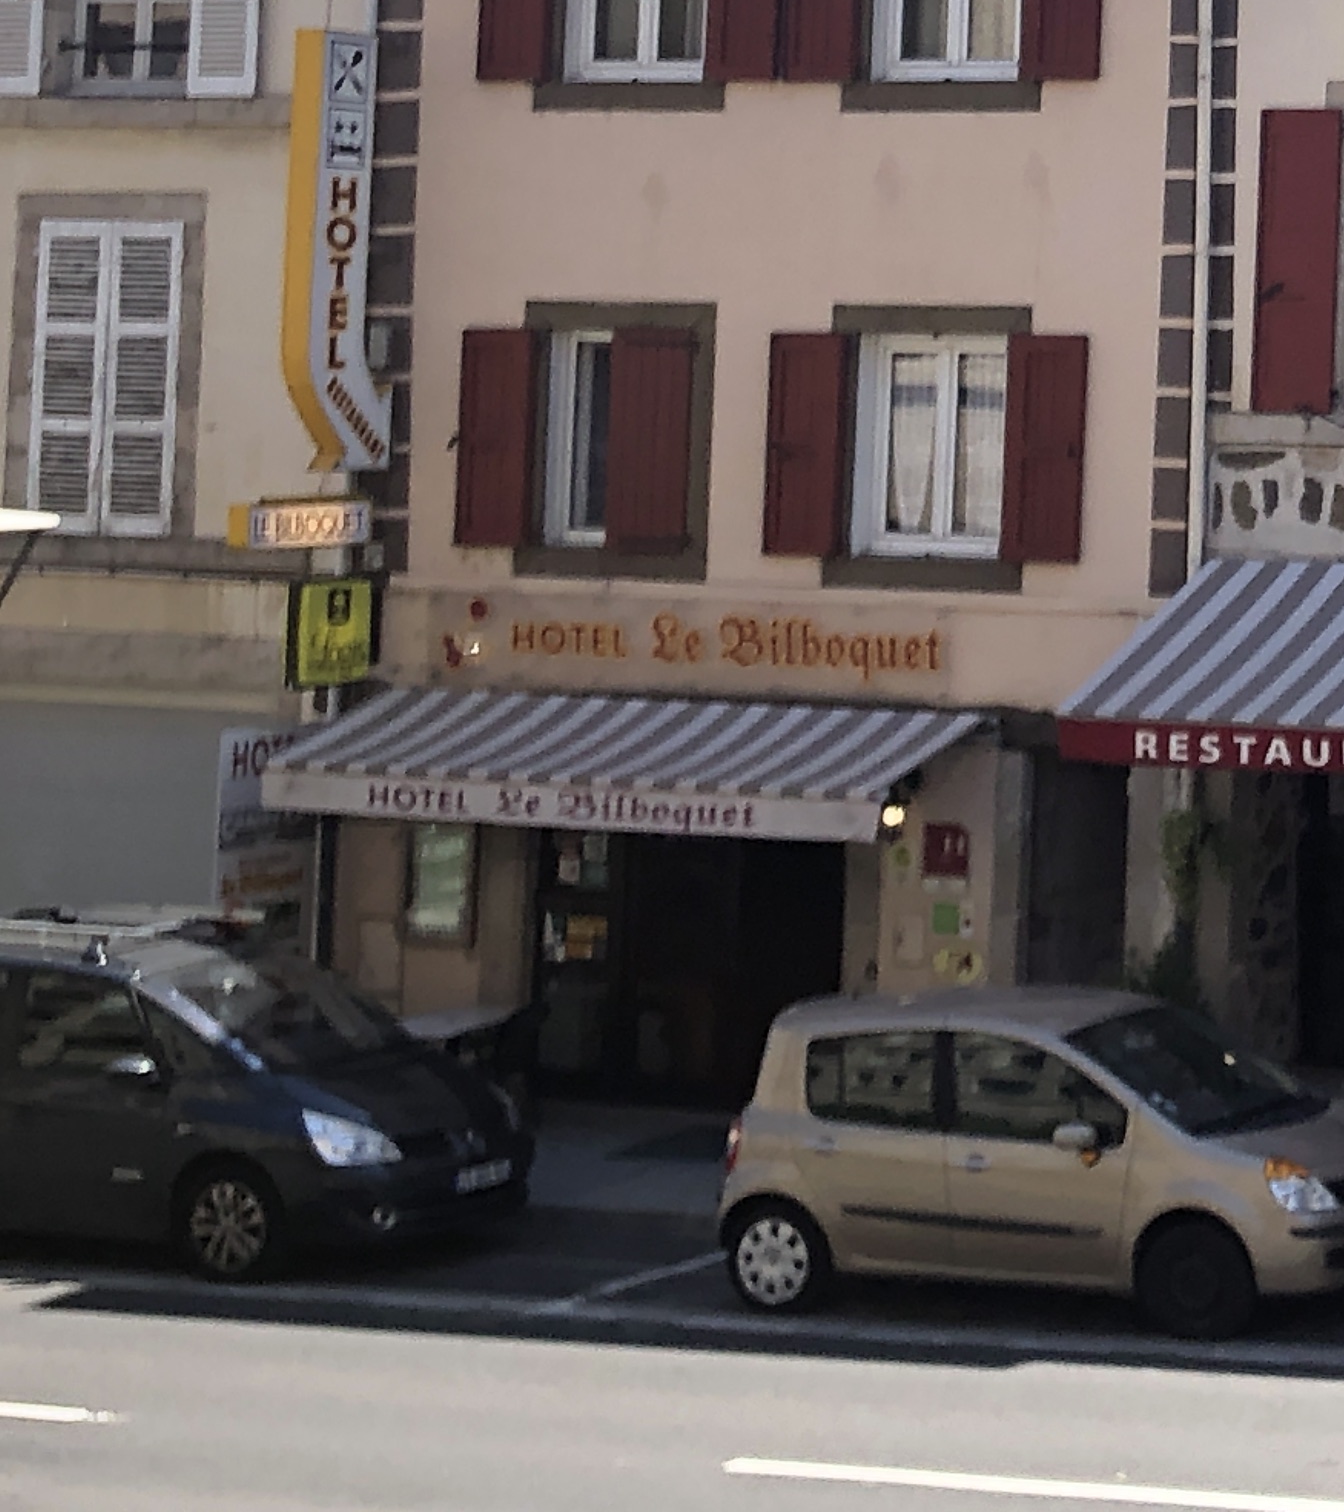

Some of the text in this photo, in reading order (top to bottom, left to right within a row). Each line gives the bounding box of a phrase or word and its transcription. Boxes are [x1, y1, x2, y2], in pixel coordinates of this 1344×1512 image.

[326, 176, 358, 370] HOTEL
[510, 611, 939, 683] HOTEL Le Bilboquet
[367, 782, 758, 833] HOTEL Le Bilboquet
